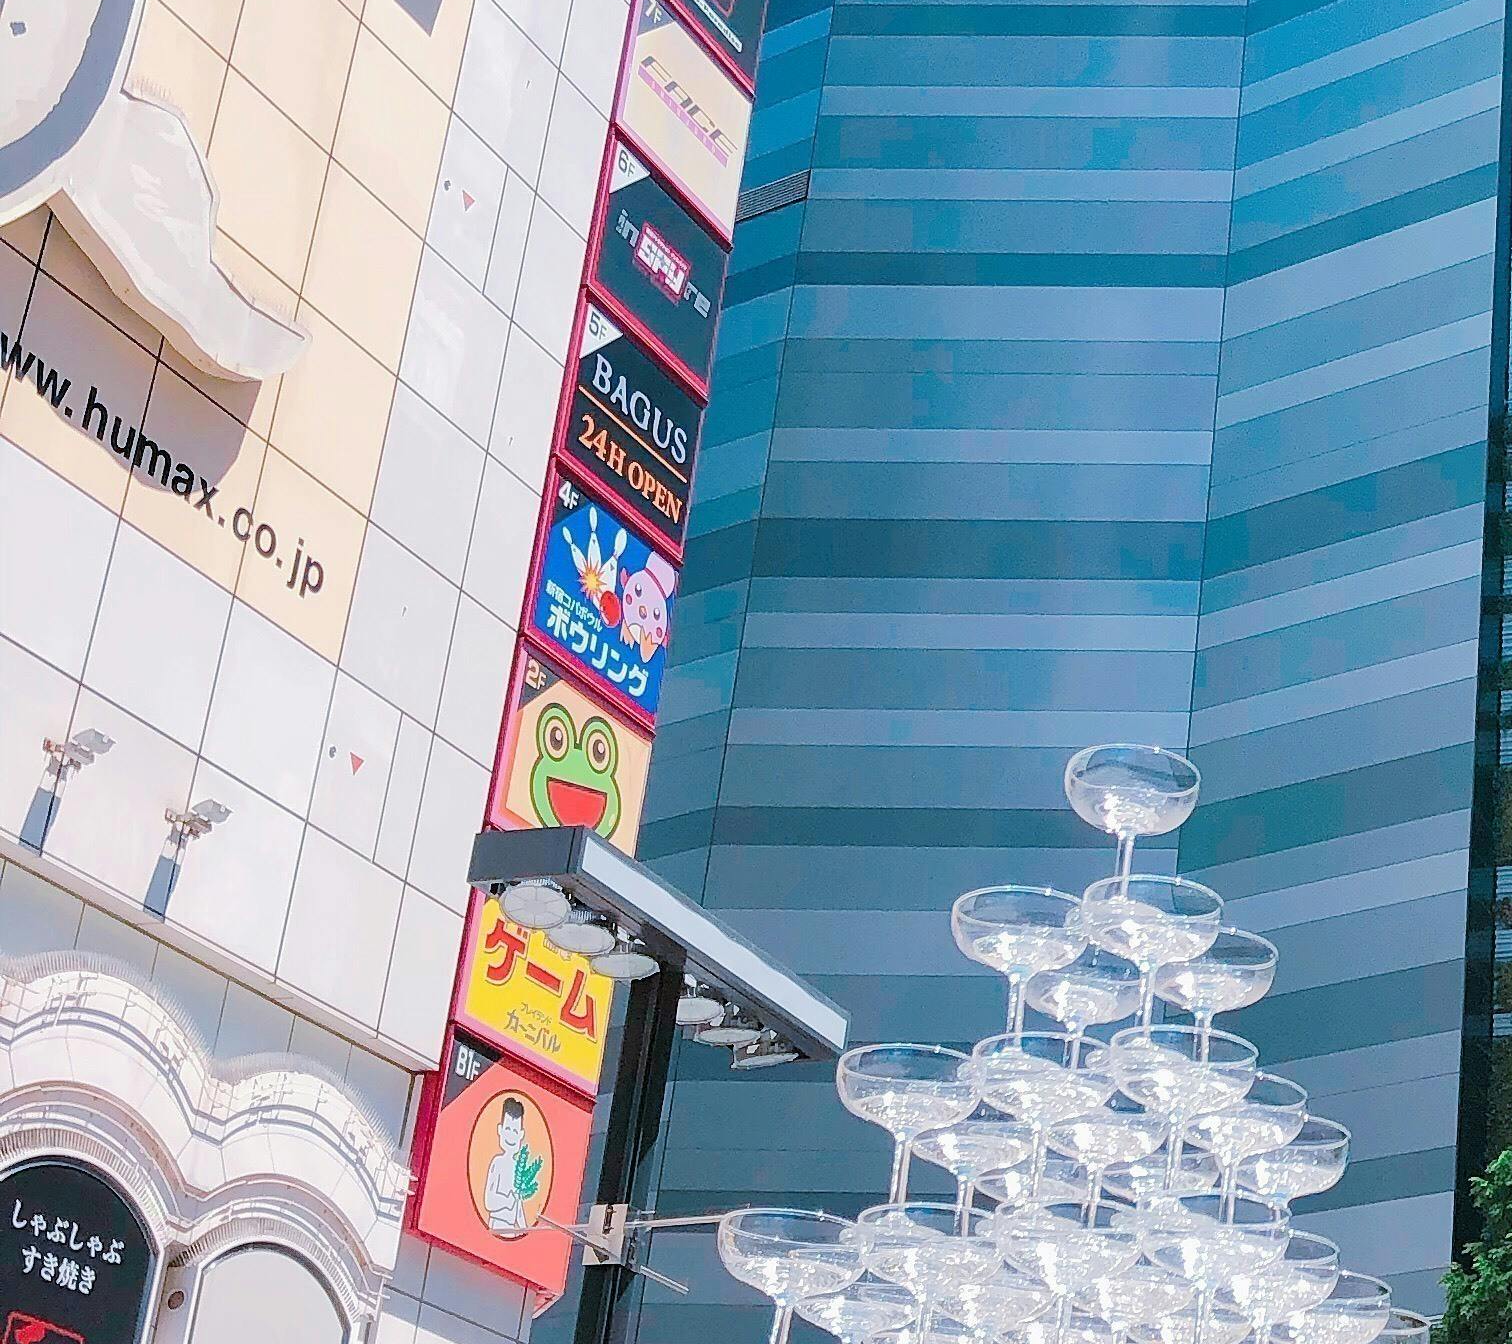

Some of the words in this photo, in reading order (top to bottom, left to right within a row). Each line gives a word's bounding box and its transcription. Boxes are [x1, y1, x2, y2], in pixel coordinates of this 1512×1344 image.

[640, 55, 738, 159] FACE
[618, 149, 636, 177] 6F
[588, 313, 608, 340] 5F
[592, 353, 688, 464] BAGUS
[578, 414, 627, 477] 24H
[627, 461, 682, 524] OPEN
[558, 479, 581, 511] 4F
[526, 658, 547, 690] 2F
[546, 603, 649, 697] ボウリング
[485, 918, 597, 1041] ゲーム
[504, 1009, 562, 1054] カーニバル
[455, 1044, 481, 1081] B1F
[12, 1198, 125, 1265] しゃぶしゃぶ
[22, 1245, 96, 1295] すき焼き
